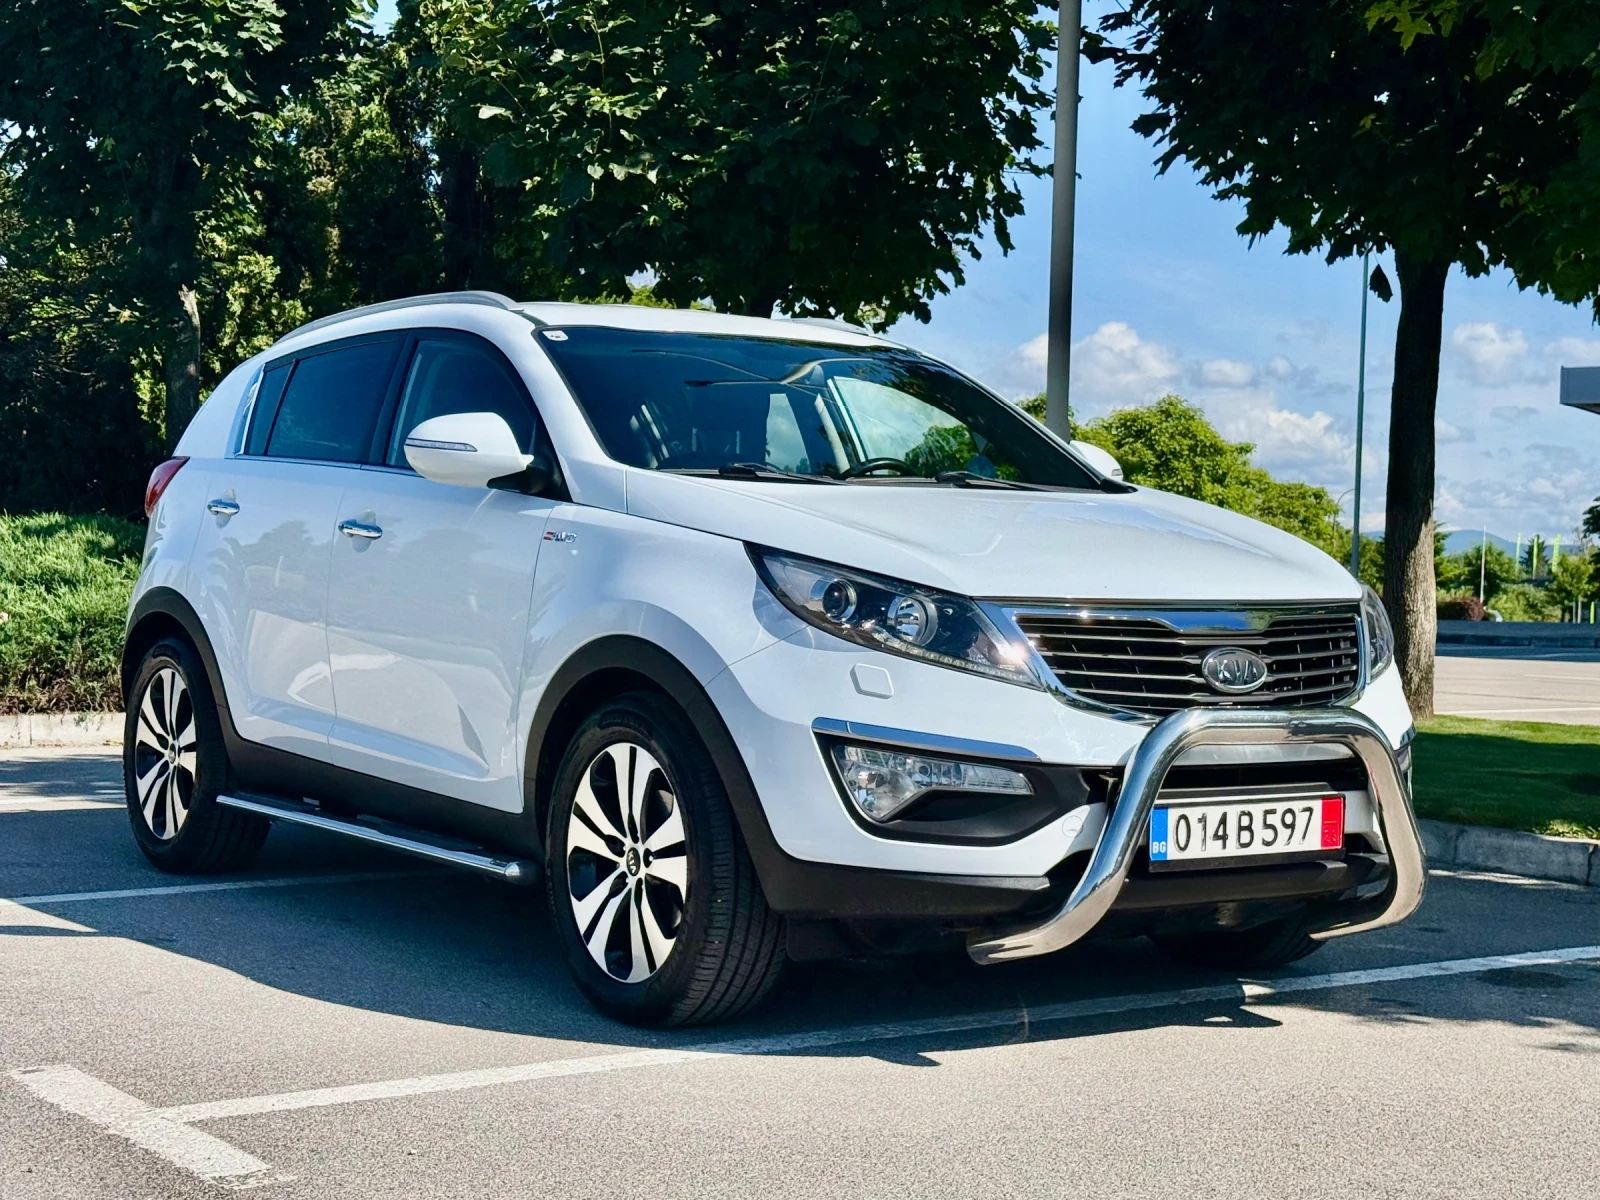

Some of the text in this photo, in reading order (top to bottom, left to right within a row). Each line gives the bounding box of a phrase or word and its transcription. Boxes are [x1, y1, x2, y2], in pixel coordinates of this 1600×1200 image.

[1214, 659, 1259, 681] KIA
[1152, 841, 1167, 854] BG
[628, 850, 637, 874] KIA
